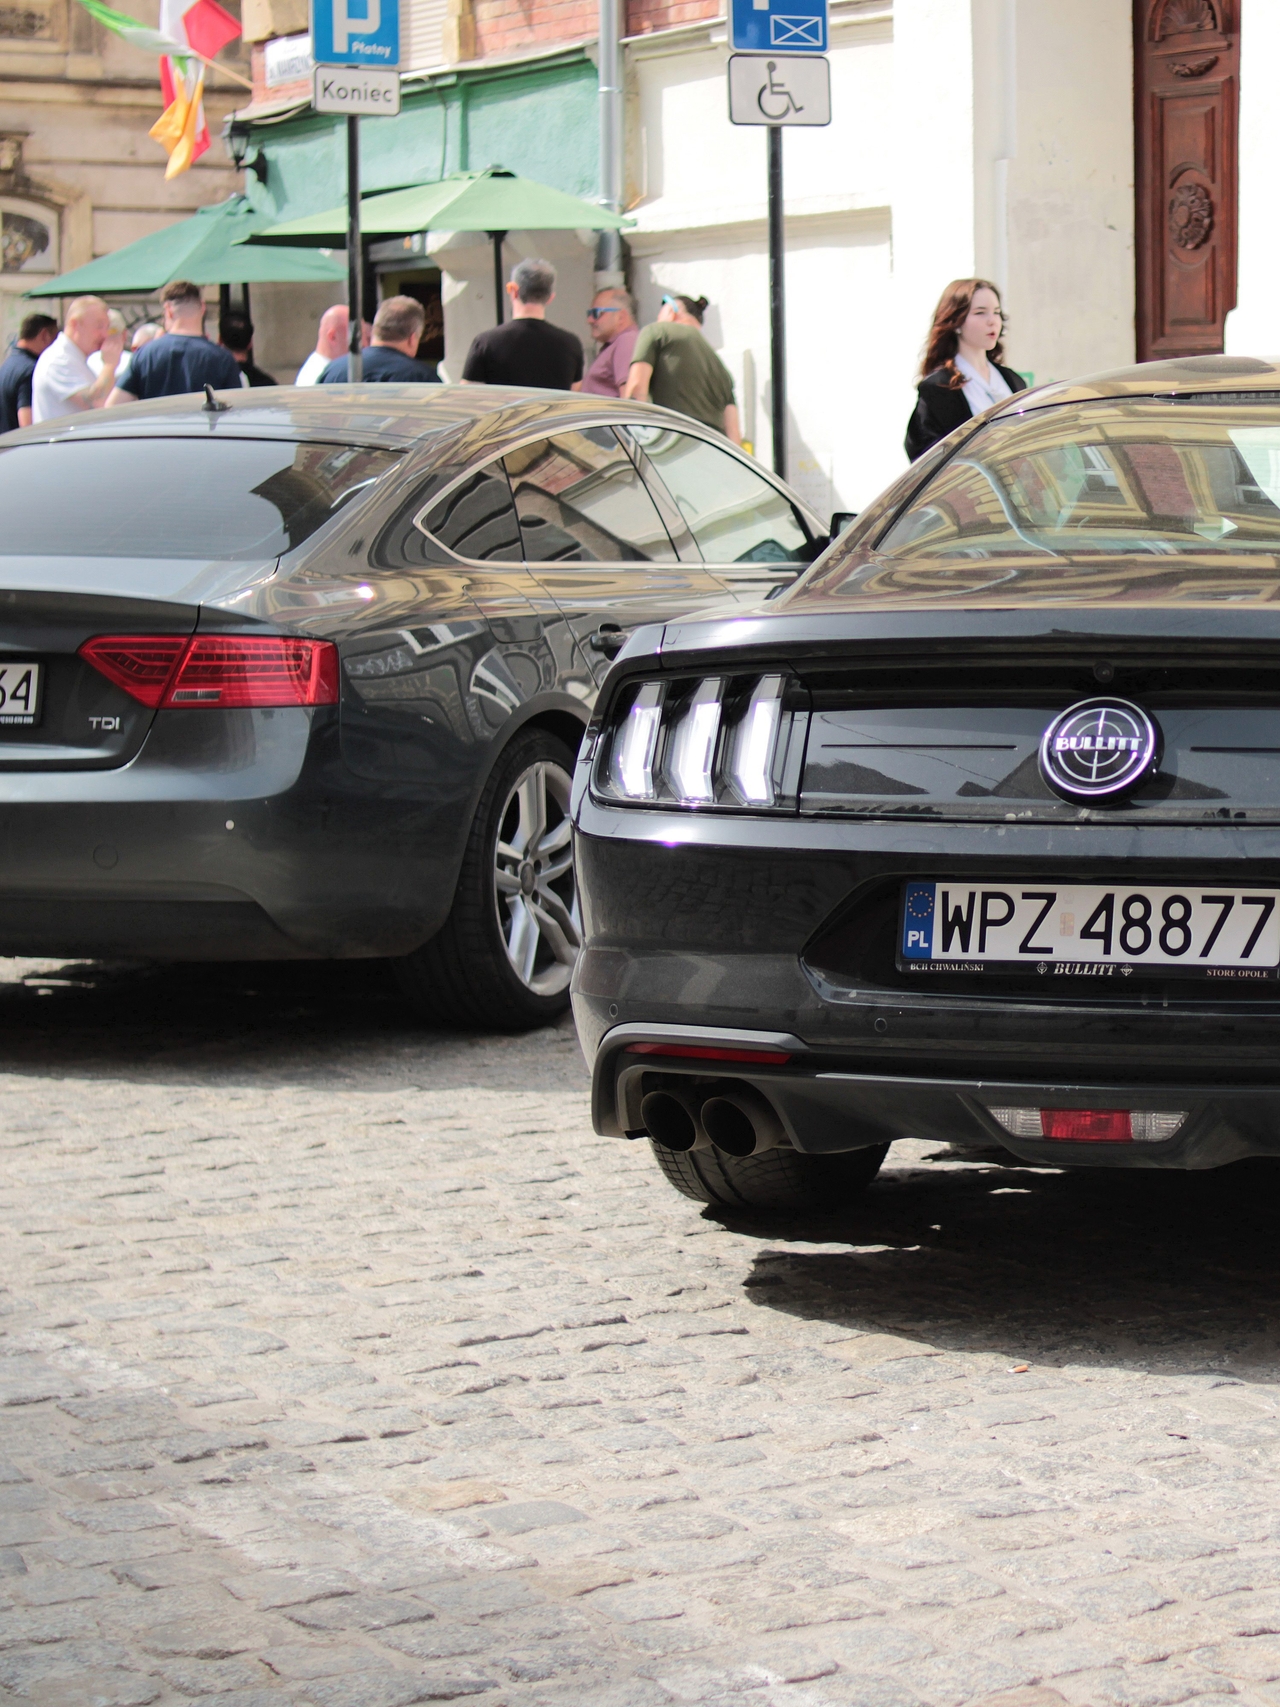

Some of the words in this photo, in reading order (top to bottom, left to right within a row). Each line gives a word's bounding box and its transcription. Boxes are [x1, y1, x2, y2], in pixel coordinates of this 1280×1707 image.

[321, 79, 394, 103] Koniec
[88, 716, 121, 730] TDI
[1055, 736, 1143, 751] BULLITT
[941, 890, 1058, 954] WPZ
[1080, 893, 1276, 959] 48877
[907, 930, 929, 948] PL
[1054, 963, 1116, 976] BULLITT
[1206, 969, 1236, 977] STORE
[1238, 970, 1269, 978] OPOLE
